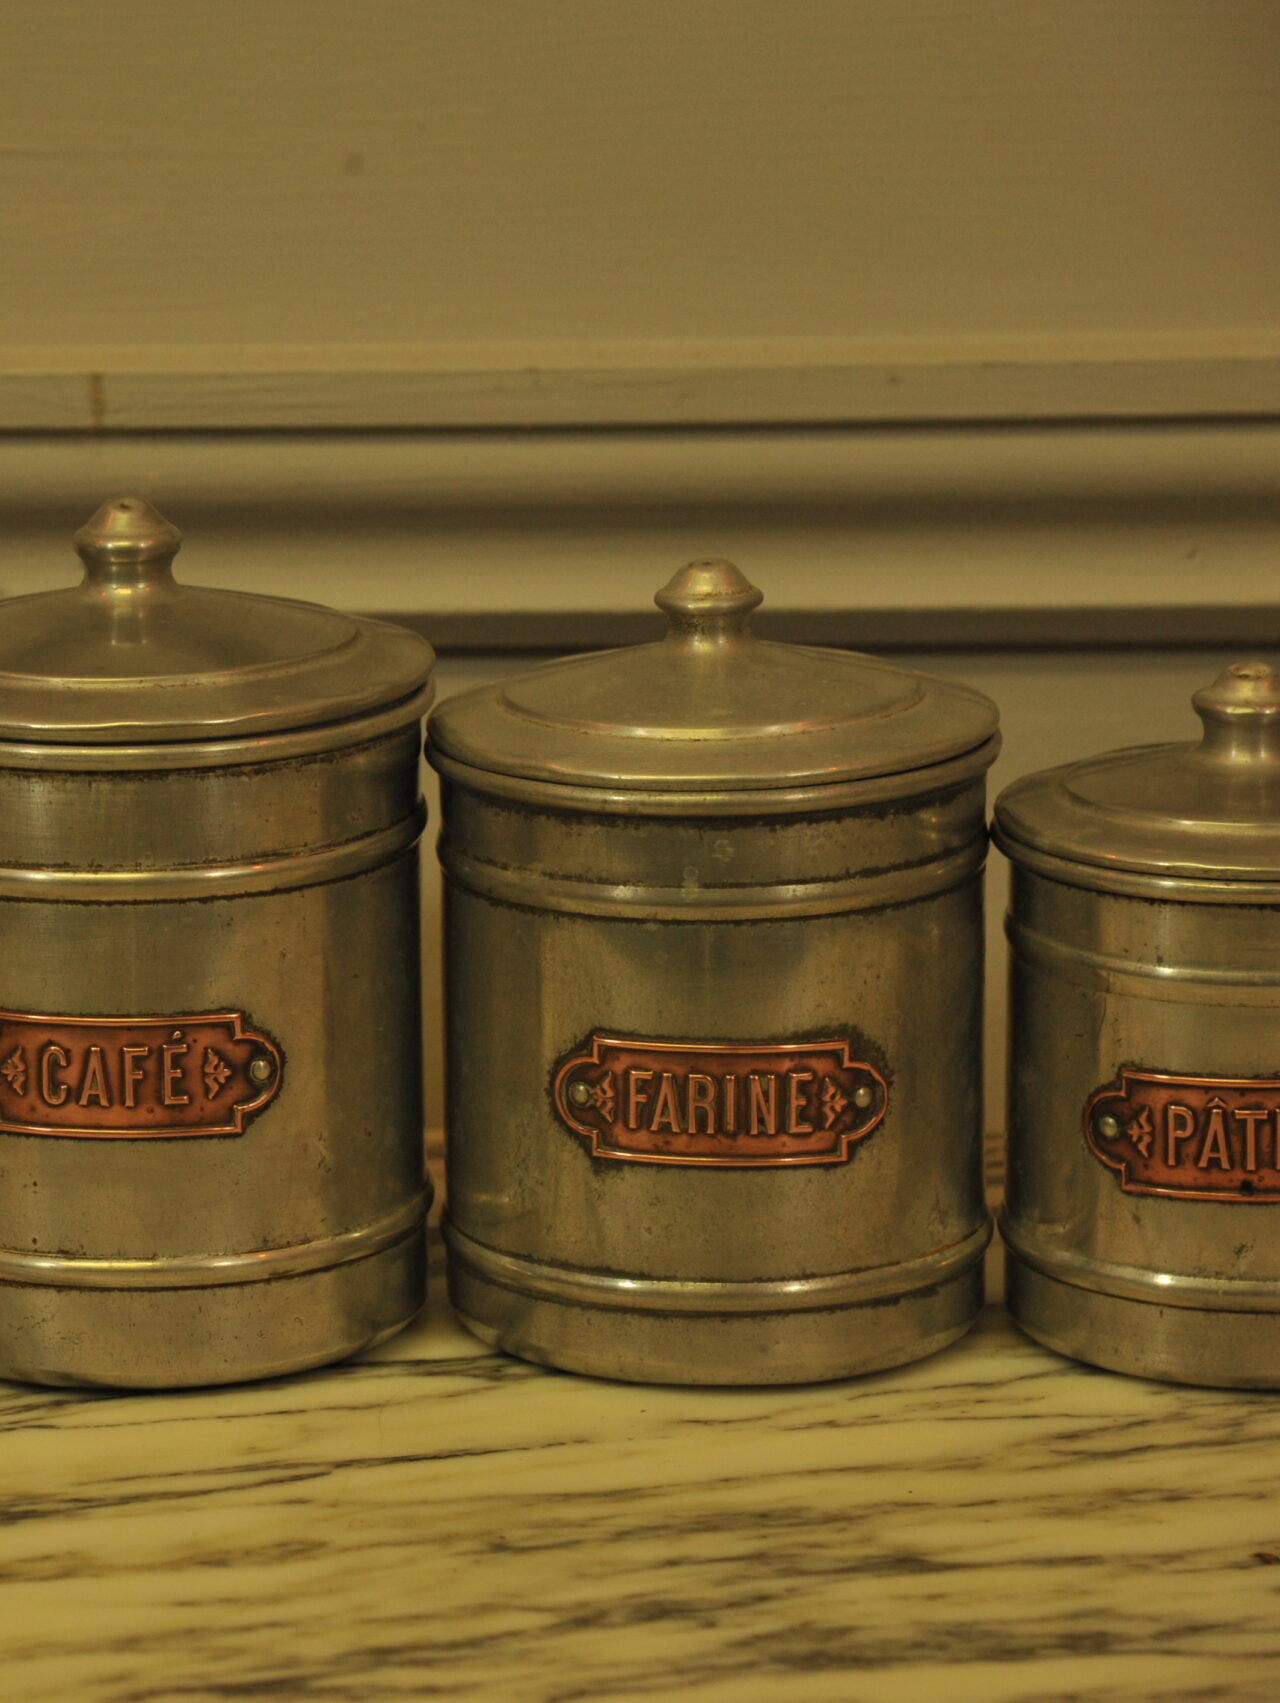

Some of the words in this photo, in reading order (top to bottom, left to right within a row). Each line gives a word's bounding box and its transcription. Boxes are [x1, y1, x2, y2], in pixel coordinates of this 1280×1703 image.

[41, 1030, 190, 1107] CAFÉ
[628, 1071, 814, 1135] FARINE
[1167, 1097, 1280, 1171] PÂT
